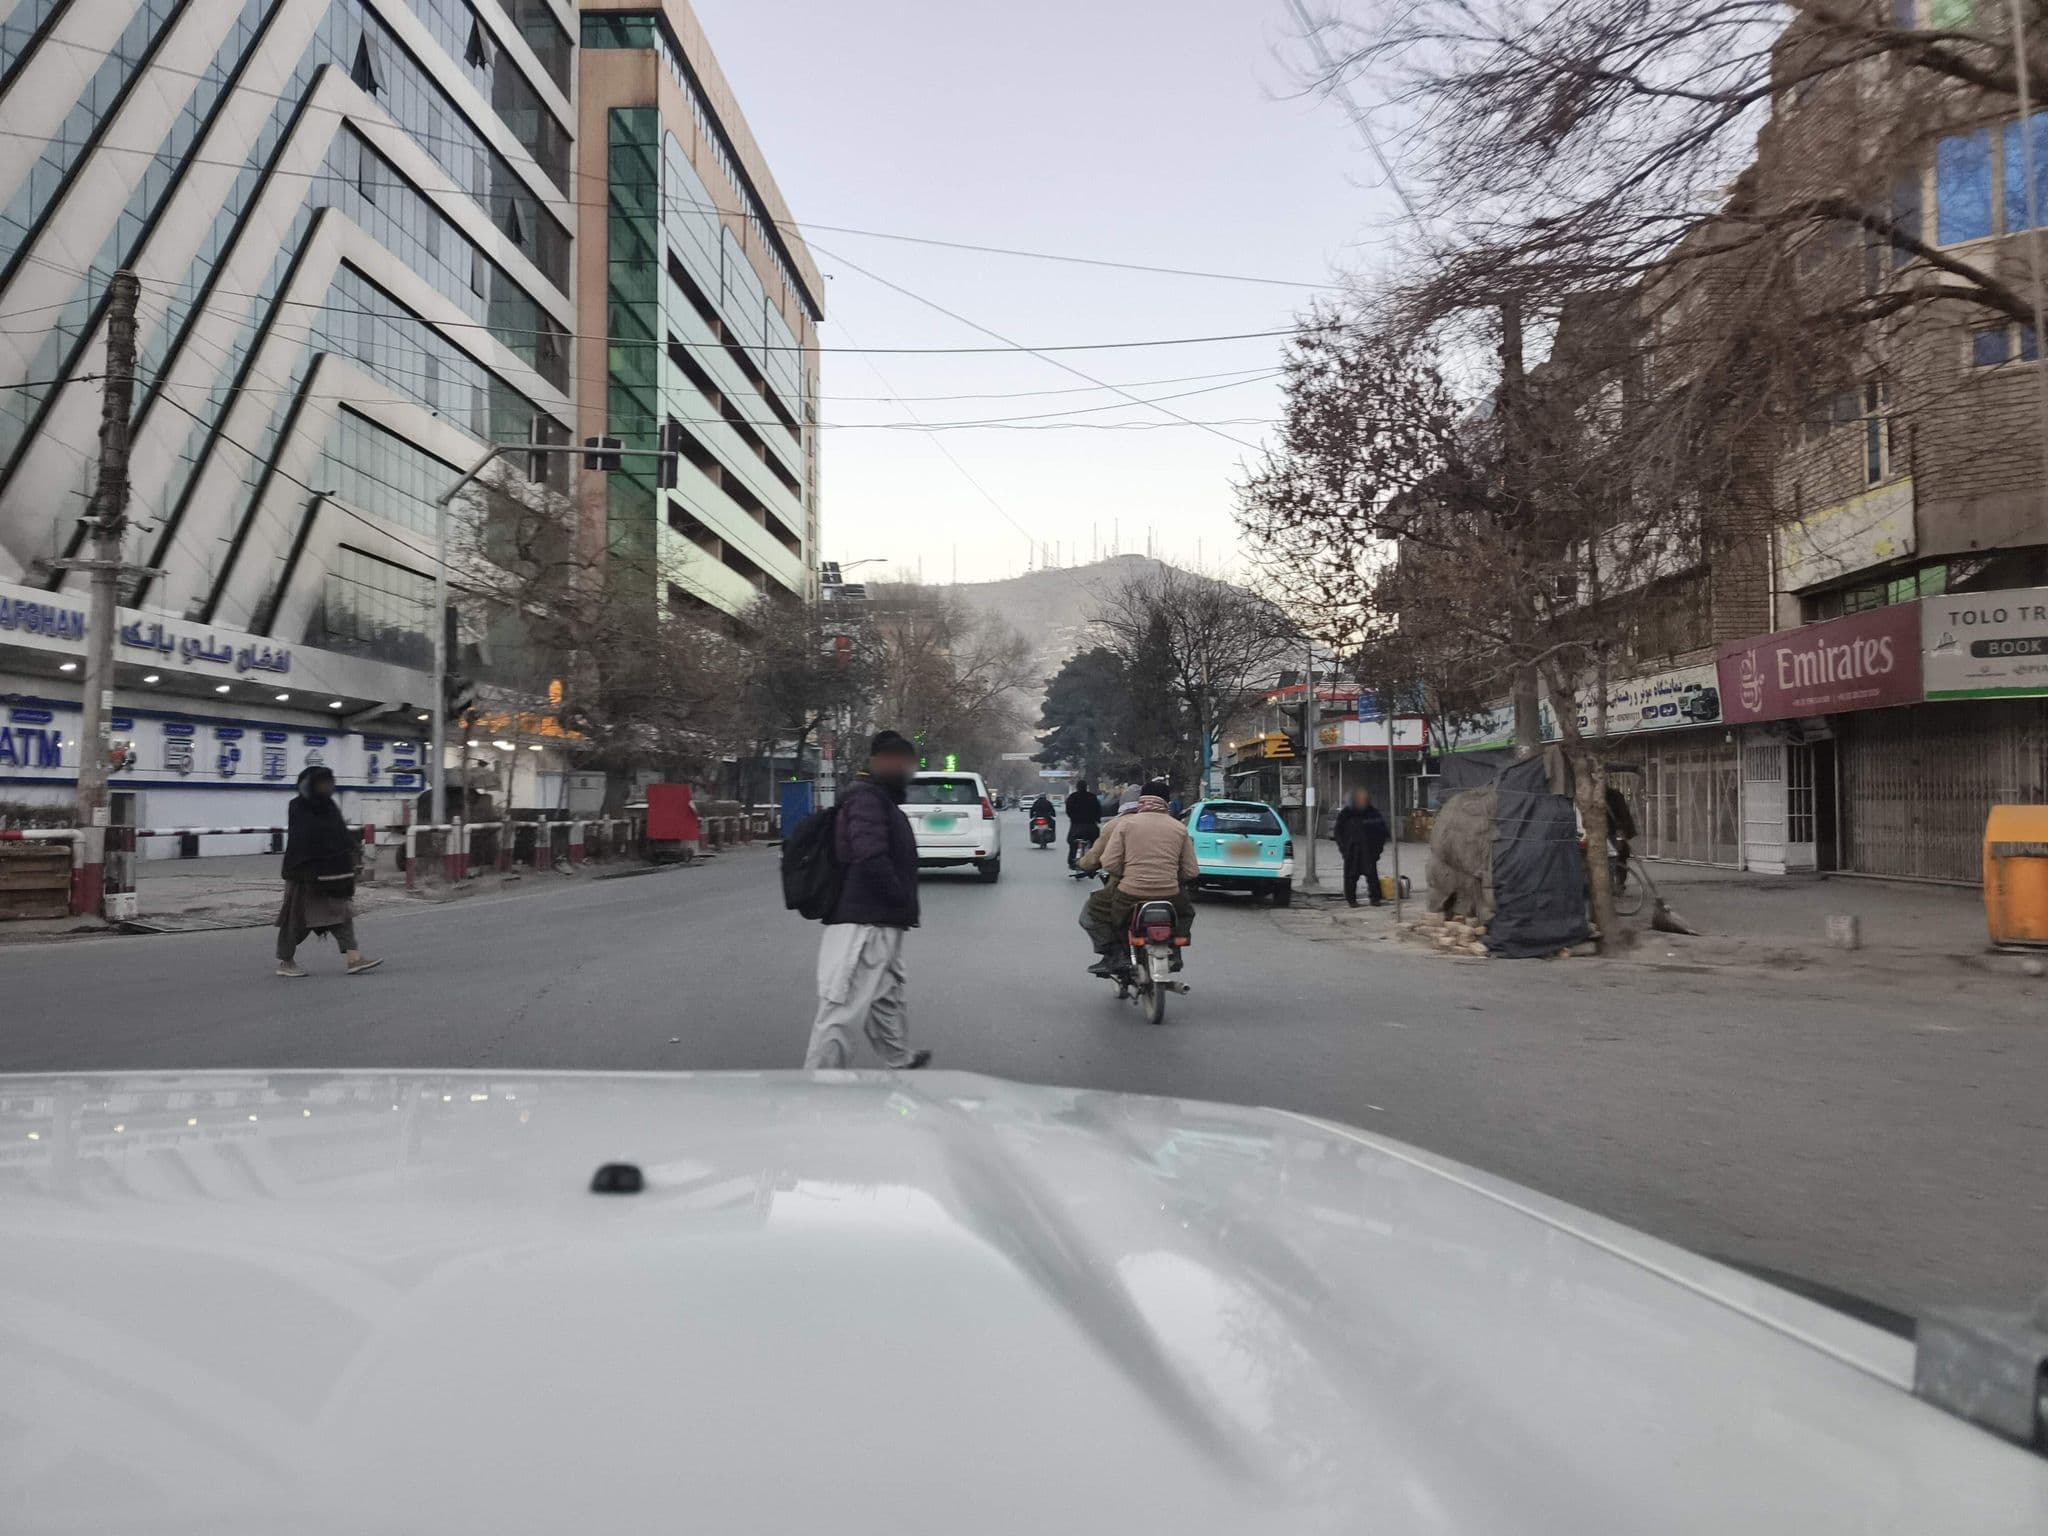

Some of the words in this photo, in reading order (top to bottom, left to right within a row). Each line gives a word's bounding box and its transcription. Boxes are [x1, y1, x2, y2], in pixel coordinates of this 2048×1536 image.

[0, 597, 85, 641] AFGHAN
[1948, 608, 2008, 626] TOLO
[236, 643, 291, 674] افغان
[1777, 635, 1894, 690] Emirates
[1988, 640, 2042, 655] BOOK
[0, 726, 61, 769] ATM
